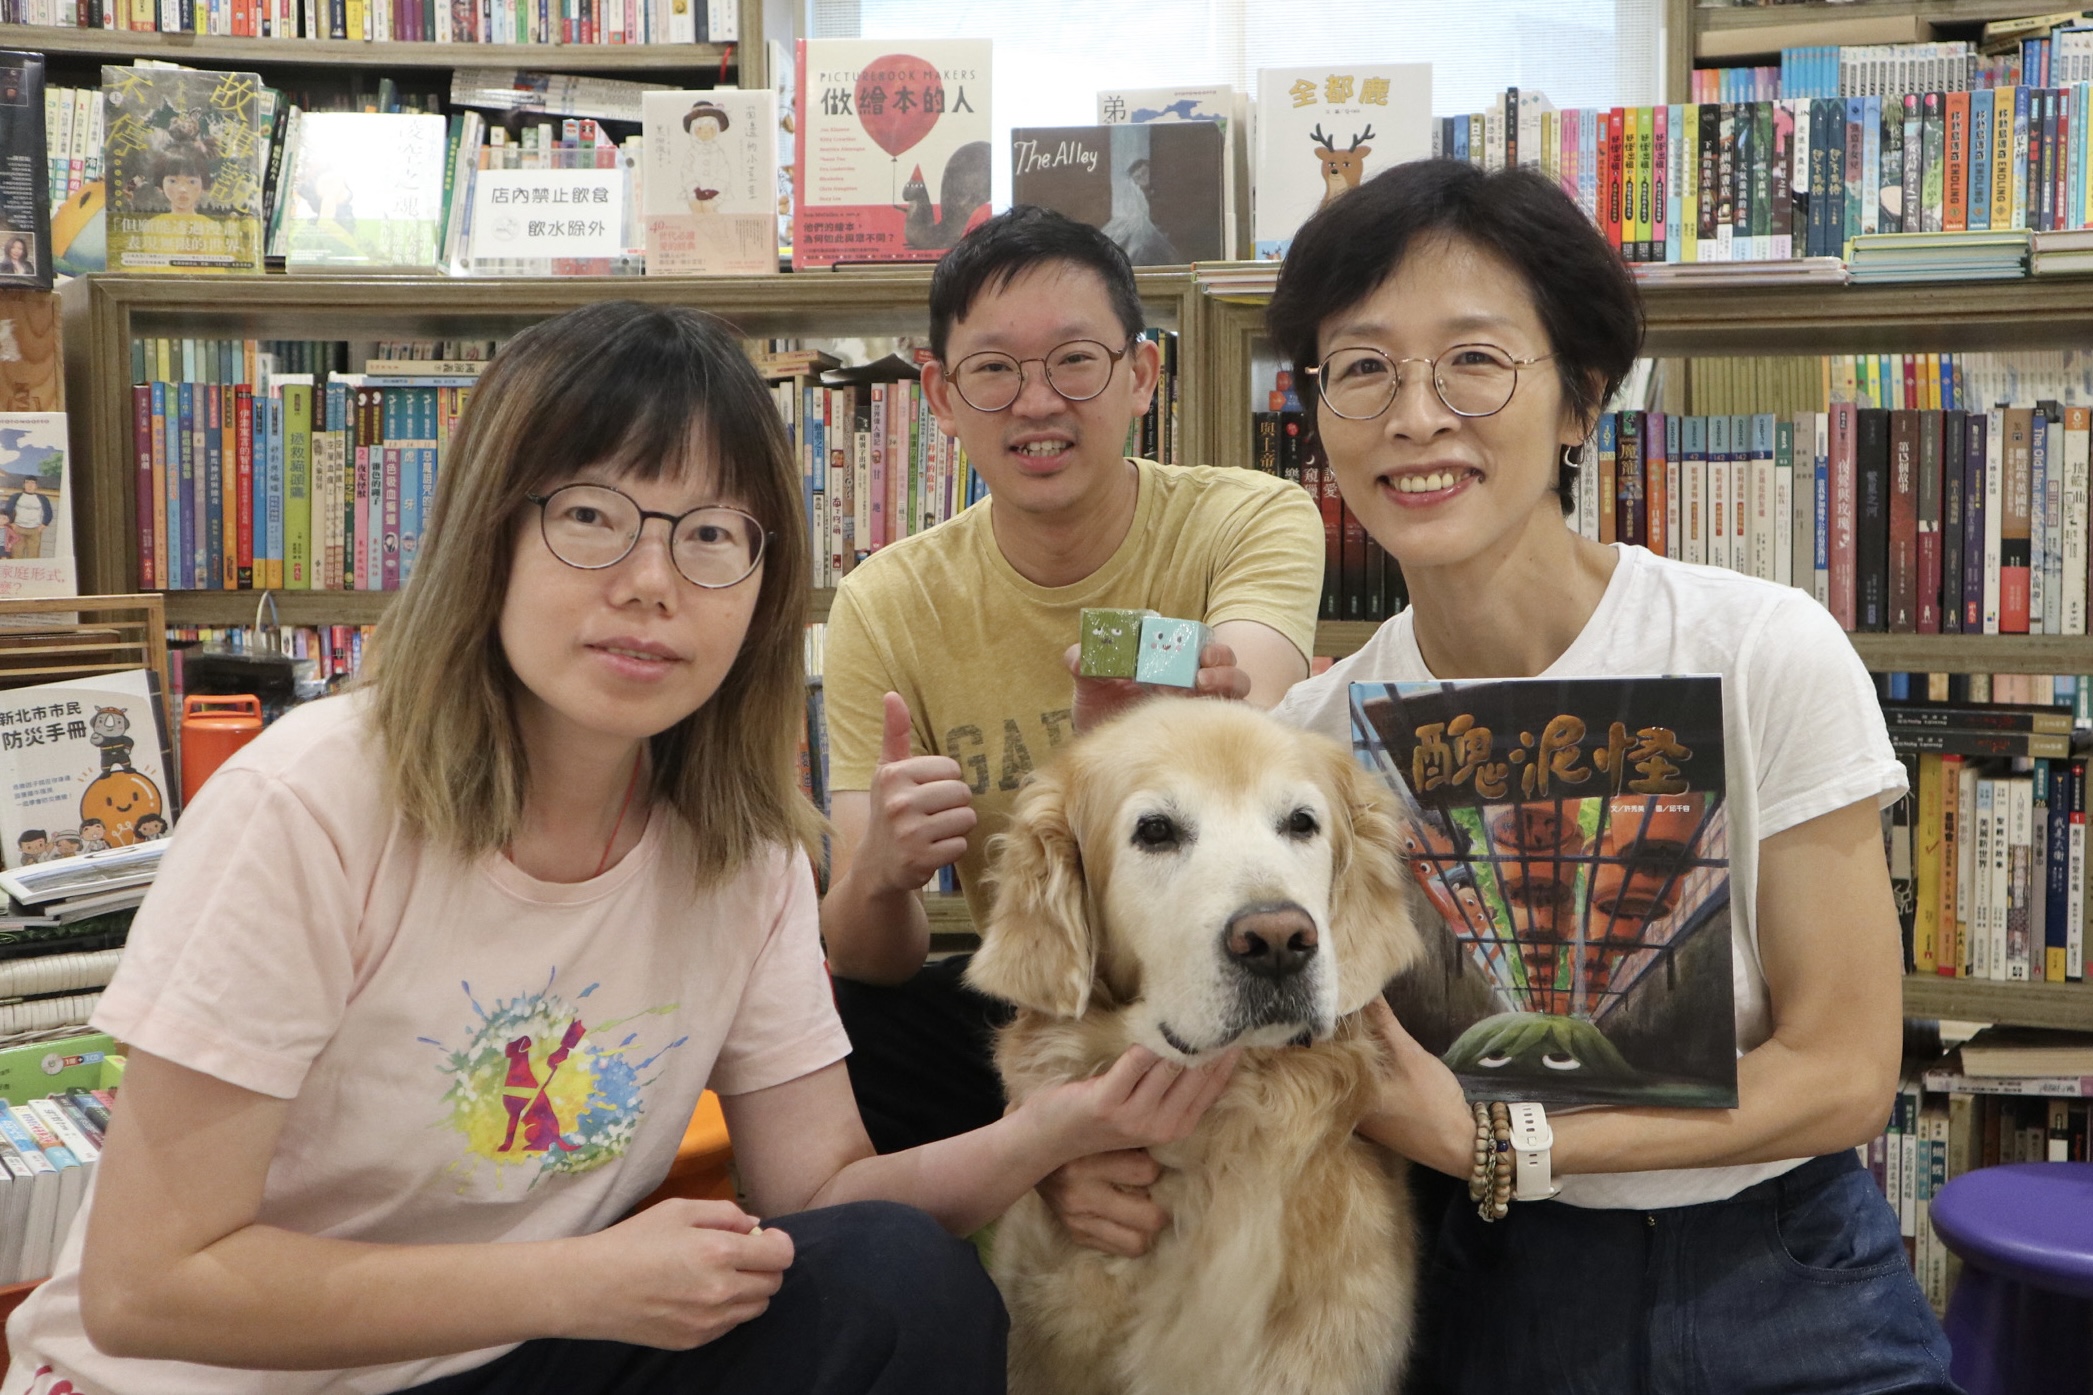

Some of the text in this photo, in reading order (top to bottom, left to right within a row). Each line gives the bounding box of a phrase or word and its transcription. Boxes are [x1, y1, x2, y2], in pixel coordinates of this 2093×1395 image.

[820, 70, 976, 82] PICTUREBOOK MAKERS
[1289, 74, 1391, 108] 全都鹿
[821, 86, 975, 116] 做繪本的人
[1014, 140, 1098, 174] The Alley
[491, 187, 609, 204] 店內禁止飲食
[1951, 163, 1960, 204] ENDLING
[1975, 163, 1985, 204] ENDLING
[1997, 162, 2007, 202] ENDLING
[528, 220, 605, 237] 飲水除外
[2034, 428, 2044, 446] The
[2034, 448, 2044, 464] Old
[2033, 467, 2043, 490] Man
[0, 702, 82, 726] 新北市市民
[2, 720, 87, 751] 防災手冊
[1412, 714, 1692, 799] 醜泥怪
